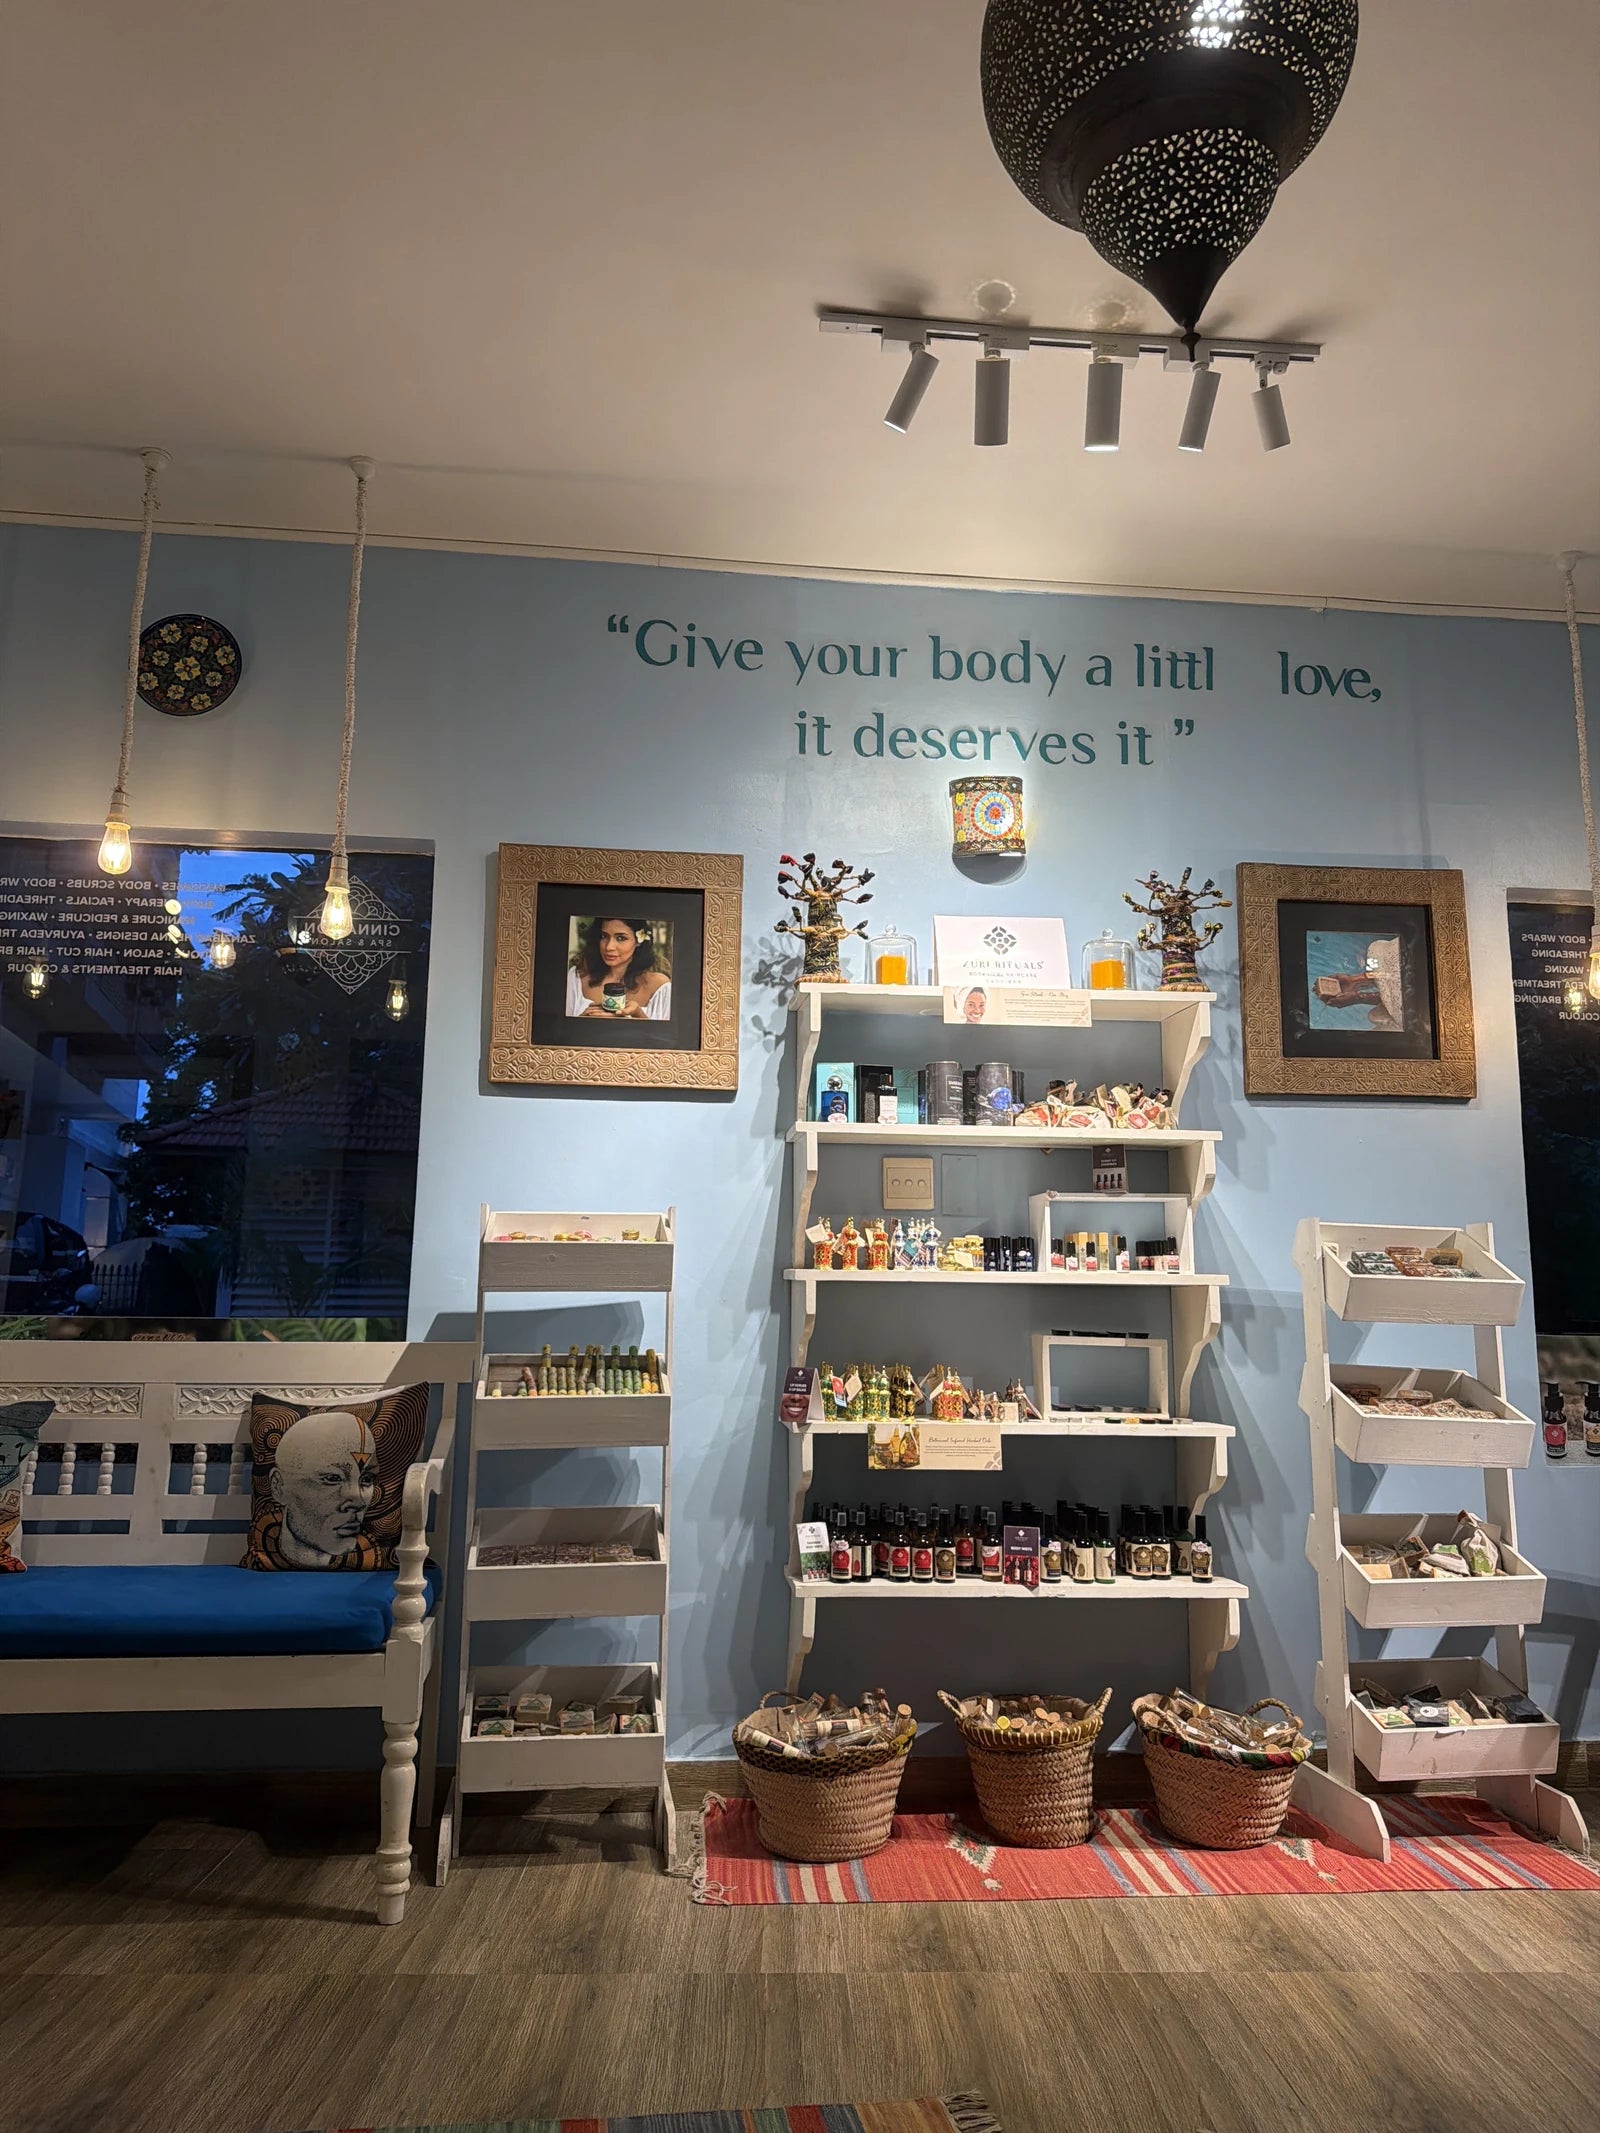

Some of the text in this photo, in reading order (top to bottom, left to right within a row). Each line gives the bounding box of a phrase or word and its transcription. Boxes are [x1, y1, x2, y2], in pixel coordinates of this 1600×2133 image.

[784, 640, 908, 687] your
[928, 634, 1067, 698] body
[1085, 654, 1112, 687] a
[1277, 650, 1382, 703] love,
[793, 710, 833, 757] it
[853, 711, 1097, 765] deserves
